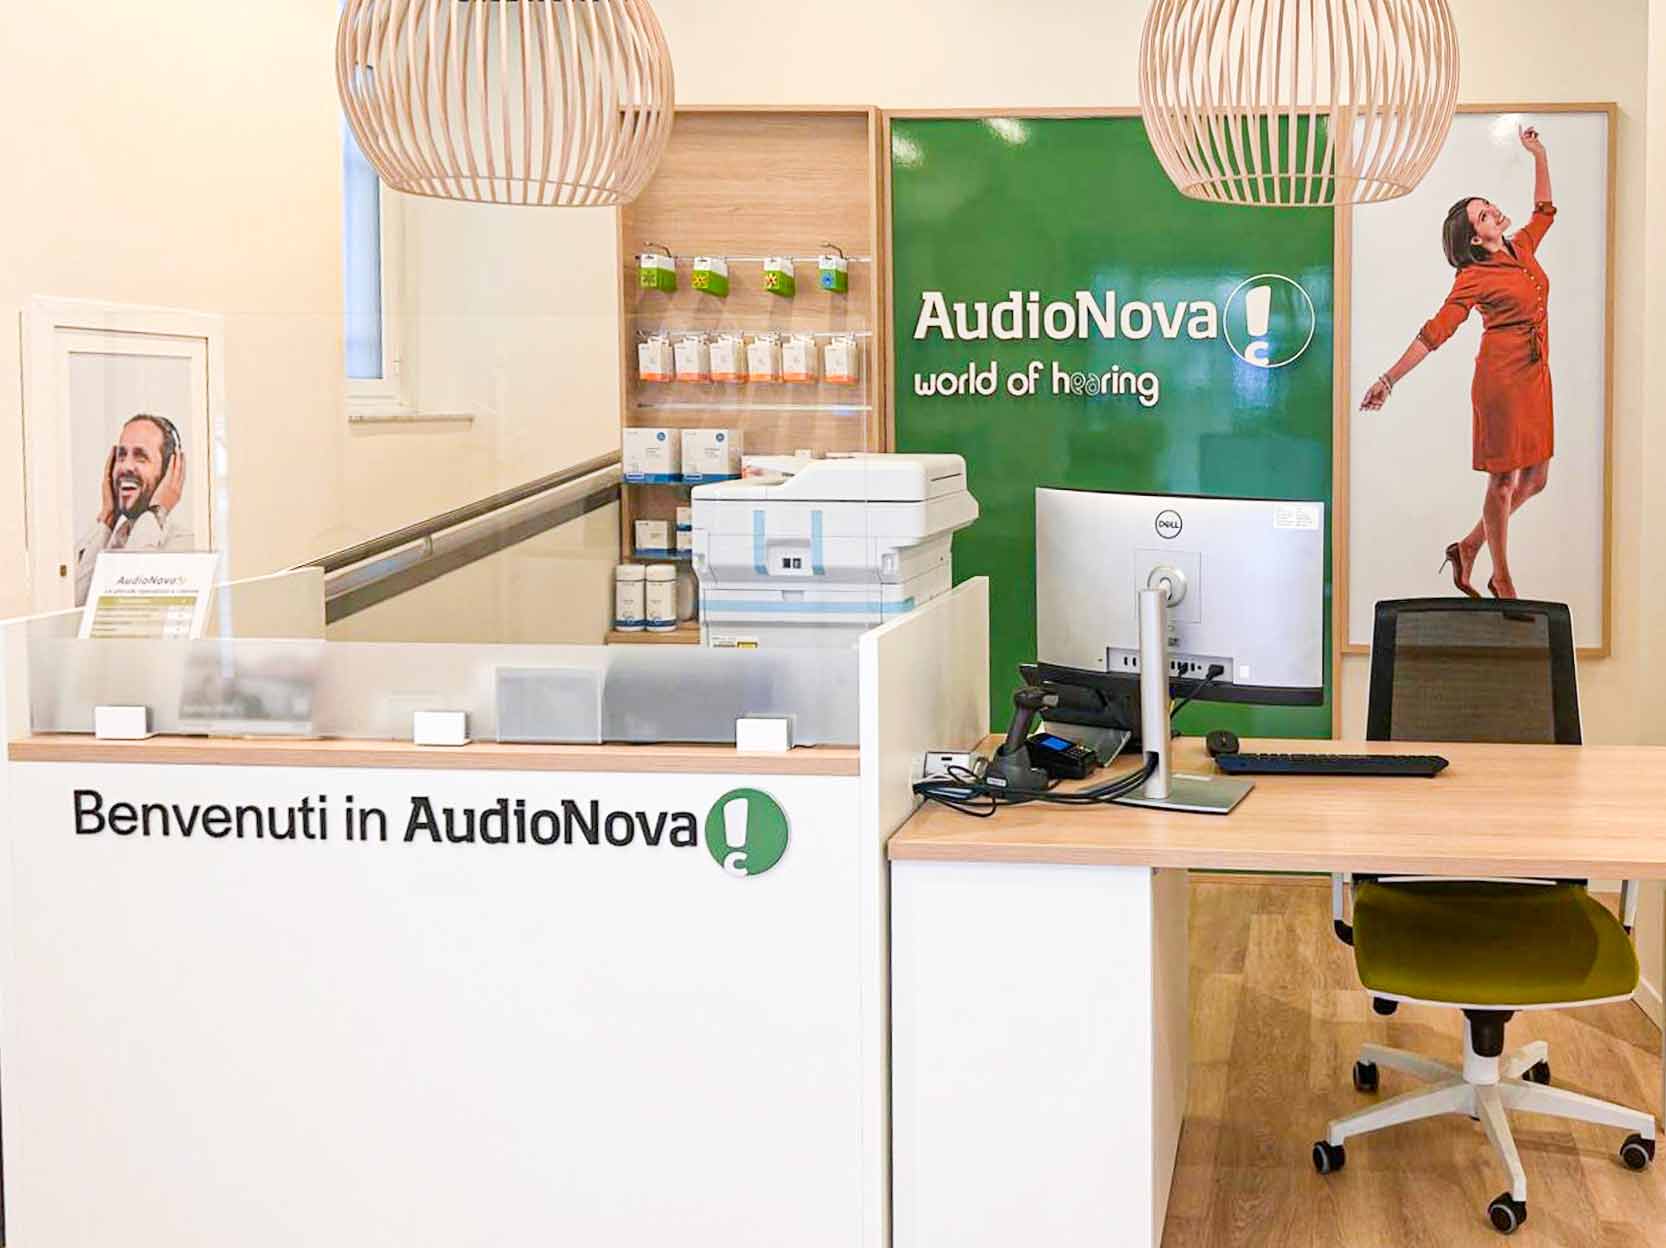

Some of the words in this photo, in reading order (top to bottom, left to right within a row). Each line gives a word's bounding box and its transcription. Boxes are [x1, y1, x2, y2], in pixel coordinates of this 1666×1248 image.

[912, 289, 1217, 340] AudioNova
[912, 360, 998, 397] world
[1006, 360, 1044, 397] of
[1052, 361, 1160, 408] hearing
[1158, 520, 1181, 529] DELL
[73, 789, 328, 840] Benvenuti
[345, 795, 387, 841] in
[403, 796, 698, 848] AudioNova
